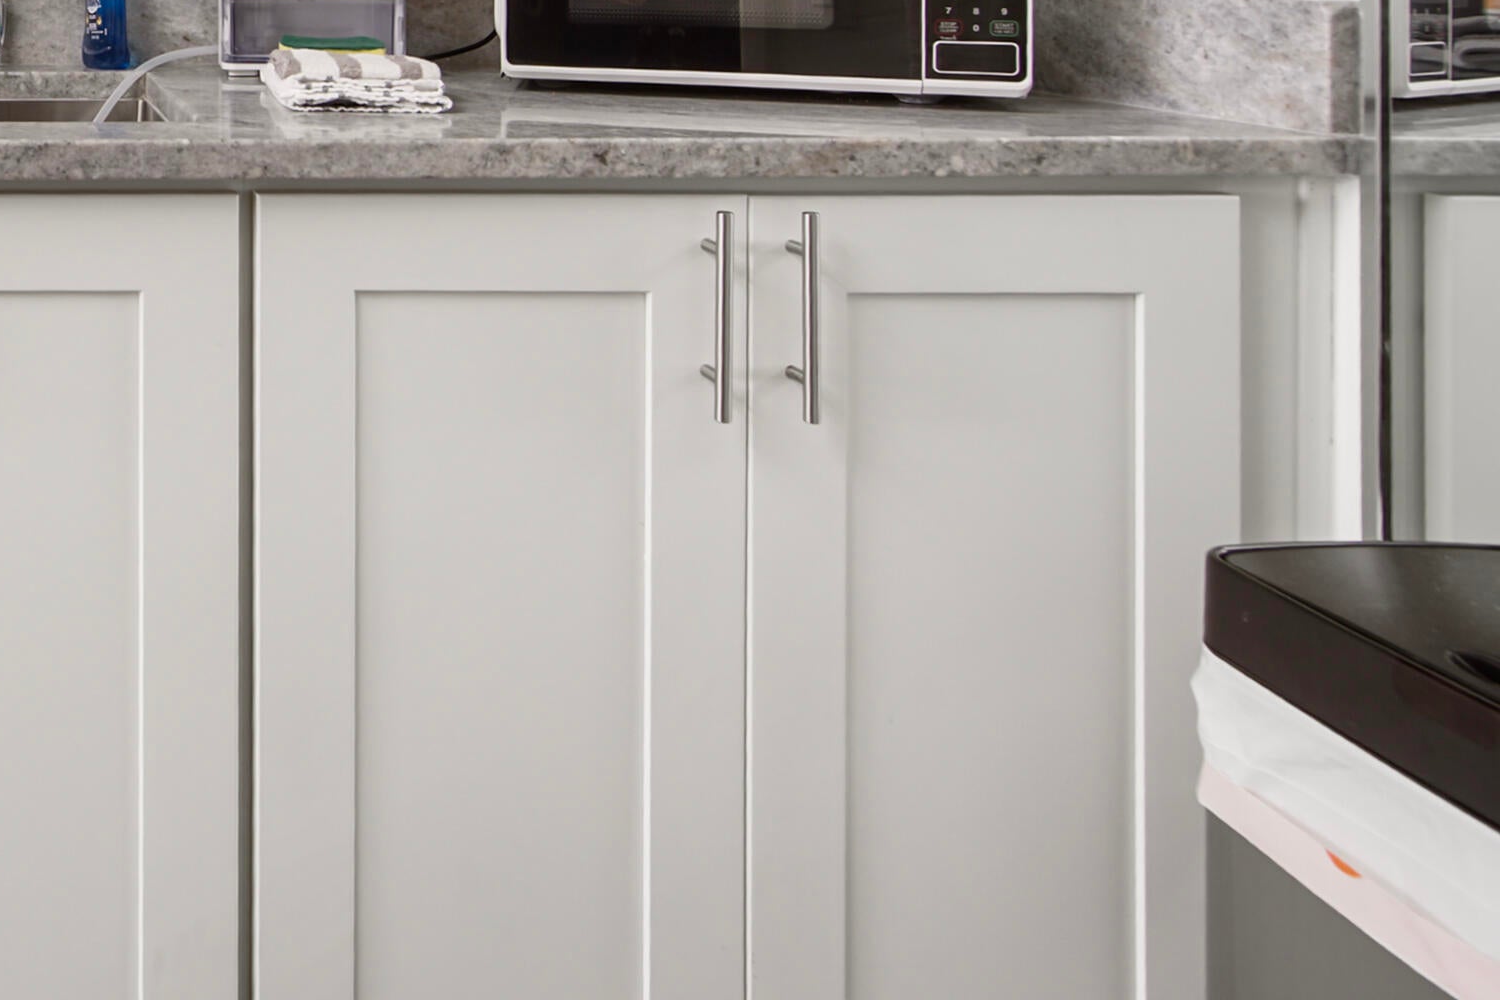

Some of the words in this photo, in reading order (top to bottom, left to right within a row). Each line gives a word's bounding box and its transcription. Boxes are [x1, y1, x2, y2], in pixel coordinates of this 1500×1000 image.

[945, 6, 952, 15] 7
[972, 7, 980, 15] 8
[1001, 7, 1008, 16] 9
[972, 24, 980, 32] 0
